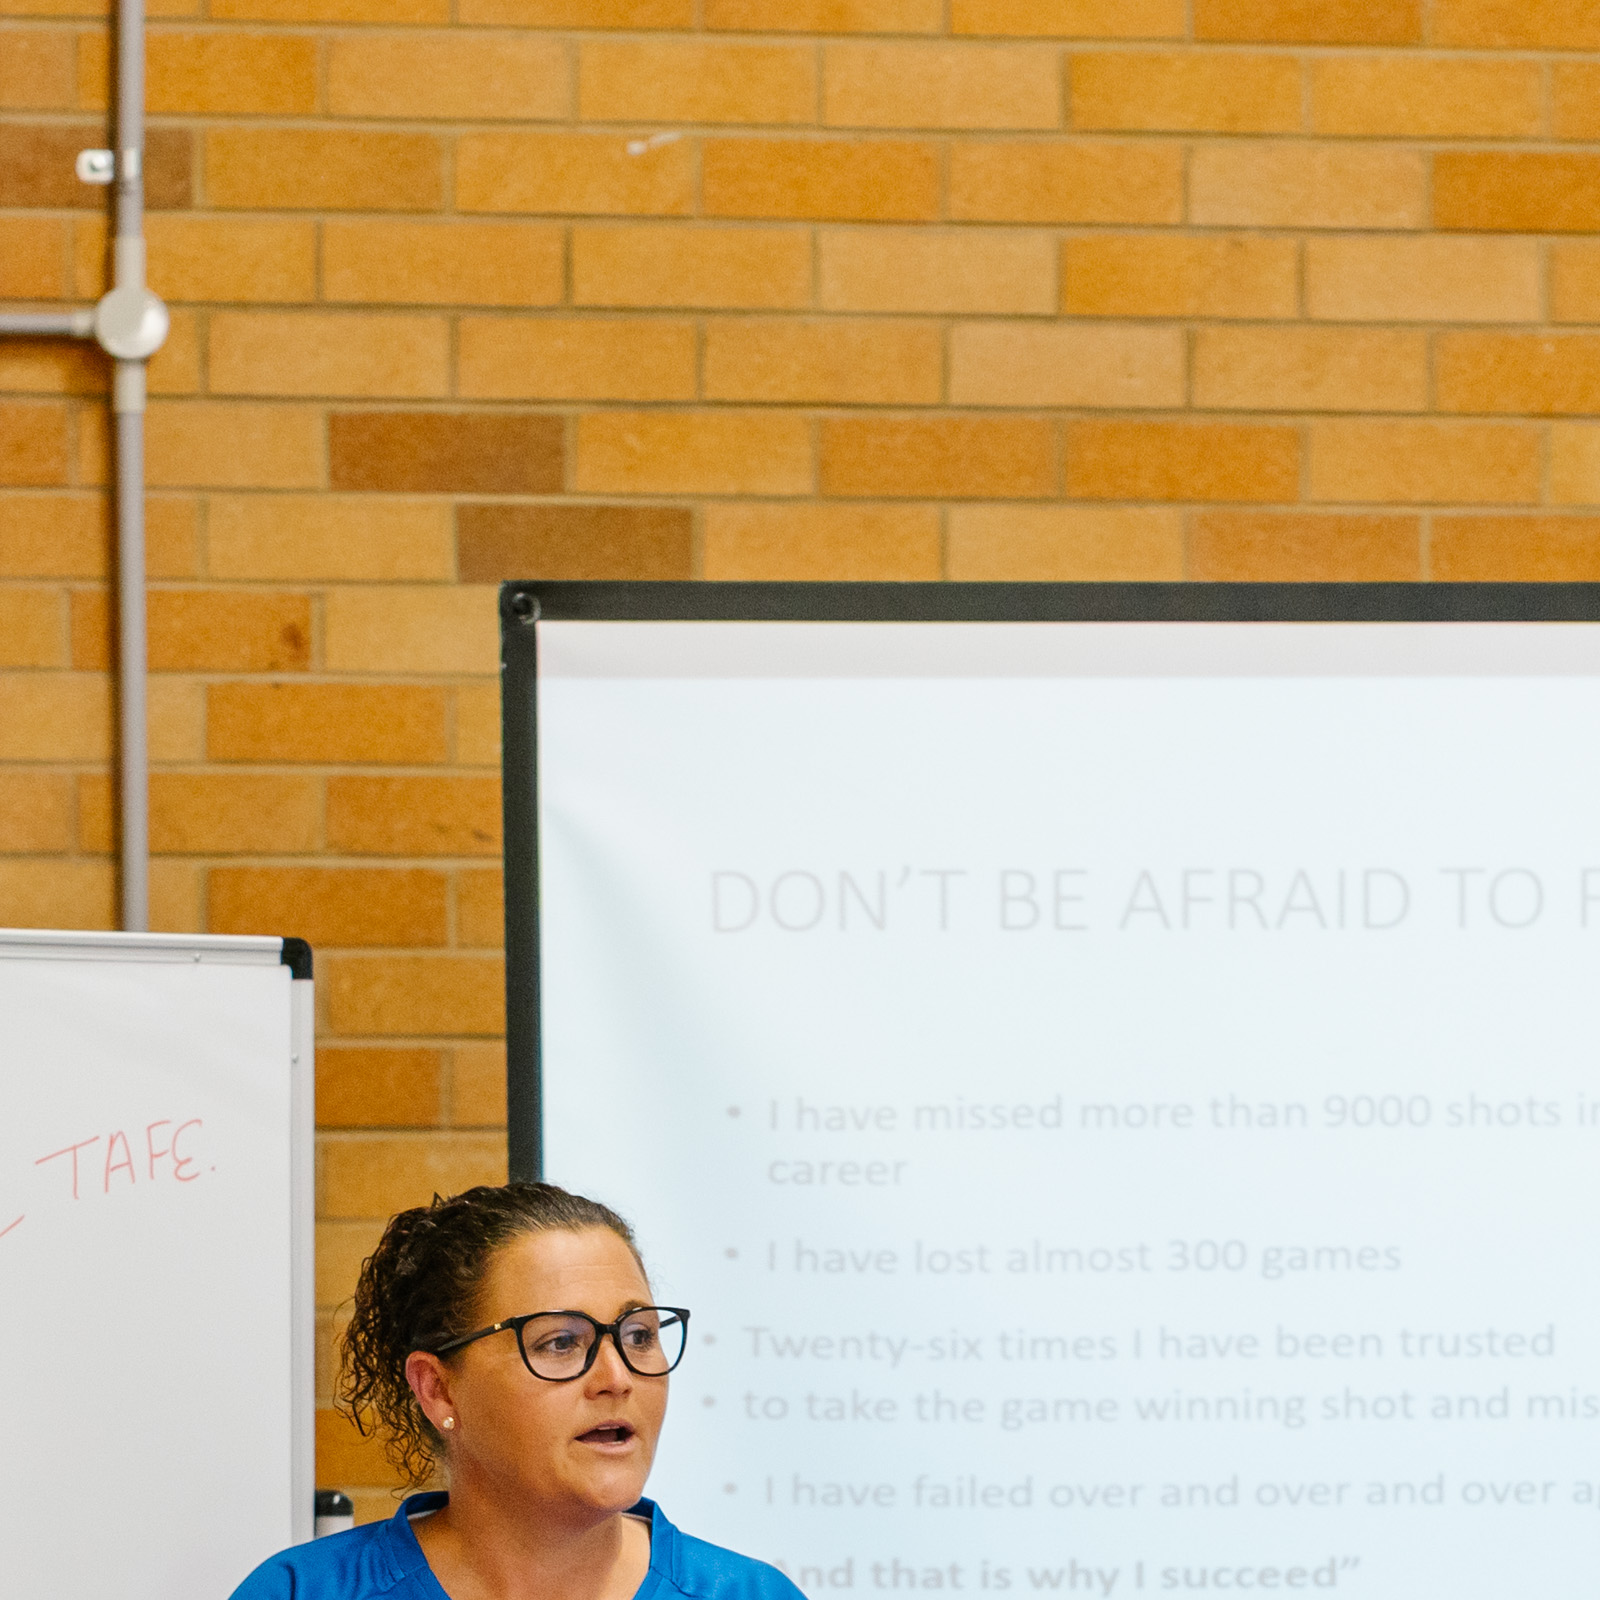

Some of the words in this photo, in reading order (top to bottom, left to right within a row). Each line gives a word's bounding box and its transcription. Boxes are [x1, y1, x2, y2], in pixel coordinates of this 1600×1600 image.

[709, 863, 969, 935] DON’T
[997, 867, 1090, 933] BE
[1117, 866, 1413, 932] AFRAID
[1437, 865, 1547, 931] TO
[767, 1097, 781, 1133] I
[795, 1096, 898, 1132] have
[913, 1093, 1064, 1131] missed
[1079, 1102, 1195, 1130] more
[1208, 1092, 1309, 1129] than
[1322, 1093, 1433, 1129] 9000
[1446, 1091, 1563, 1128] shots
[765, 1158, 908, 1187] career
[765, 1238, 779, 1273] I
[793, 1237, 899, 1276] have
[914, 1239, 991, 1276] lost
[1005, 1238, 1152, 1275] almost
[1167, 1238, 1249, 1273] 300
[1260, 1245, 1403, 1282] games
[744, 1325, 983, 1369] Twenty-six
[996, 1327, 1118, 1362] times
[1131, 1327, 1144, 1360] I
[1158, 1325, 1260, 1360] have
[1275, 1324, 1384, 1359] been
[1398, 1322, 1557, 1359] trusted
[742, 1390, 791, 1422] to
[803, 1388, 899, 1423] take
[913, 1389, 986, 1423] the
[999, 1397, 1120, 1432] game
[1133, 1395, 1308, 1430] winning
[1321, 1386, 1415, 1421] shot
[1429, 1385, 1511, 1421] and
[763, 1472, 776, 1507] I
[791, 1472, 898, 1509] have
[911, 1473, 1035, 1509] failed
[1047, 1483, 1145, 1509] over
[1159, 1473, 1241, 1509] and
[1253, 1481, 1352, 1508] over
[1364, 1471, 1446, 1507] and
[1459, 1480, 1557, 1507] over
[871, 1556, 965, 1592] that
[979, 1558, 1014, 1592] is
[1025, 1557, 1122, 1600] why
[1132, 1558, 1147, 1592] I
[1160, 1555, 1362, 1591] succeed”
